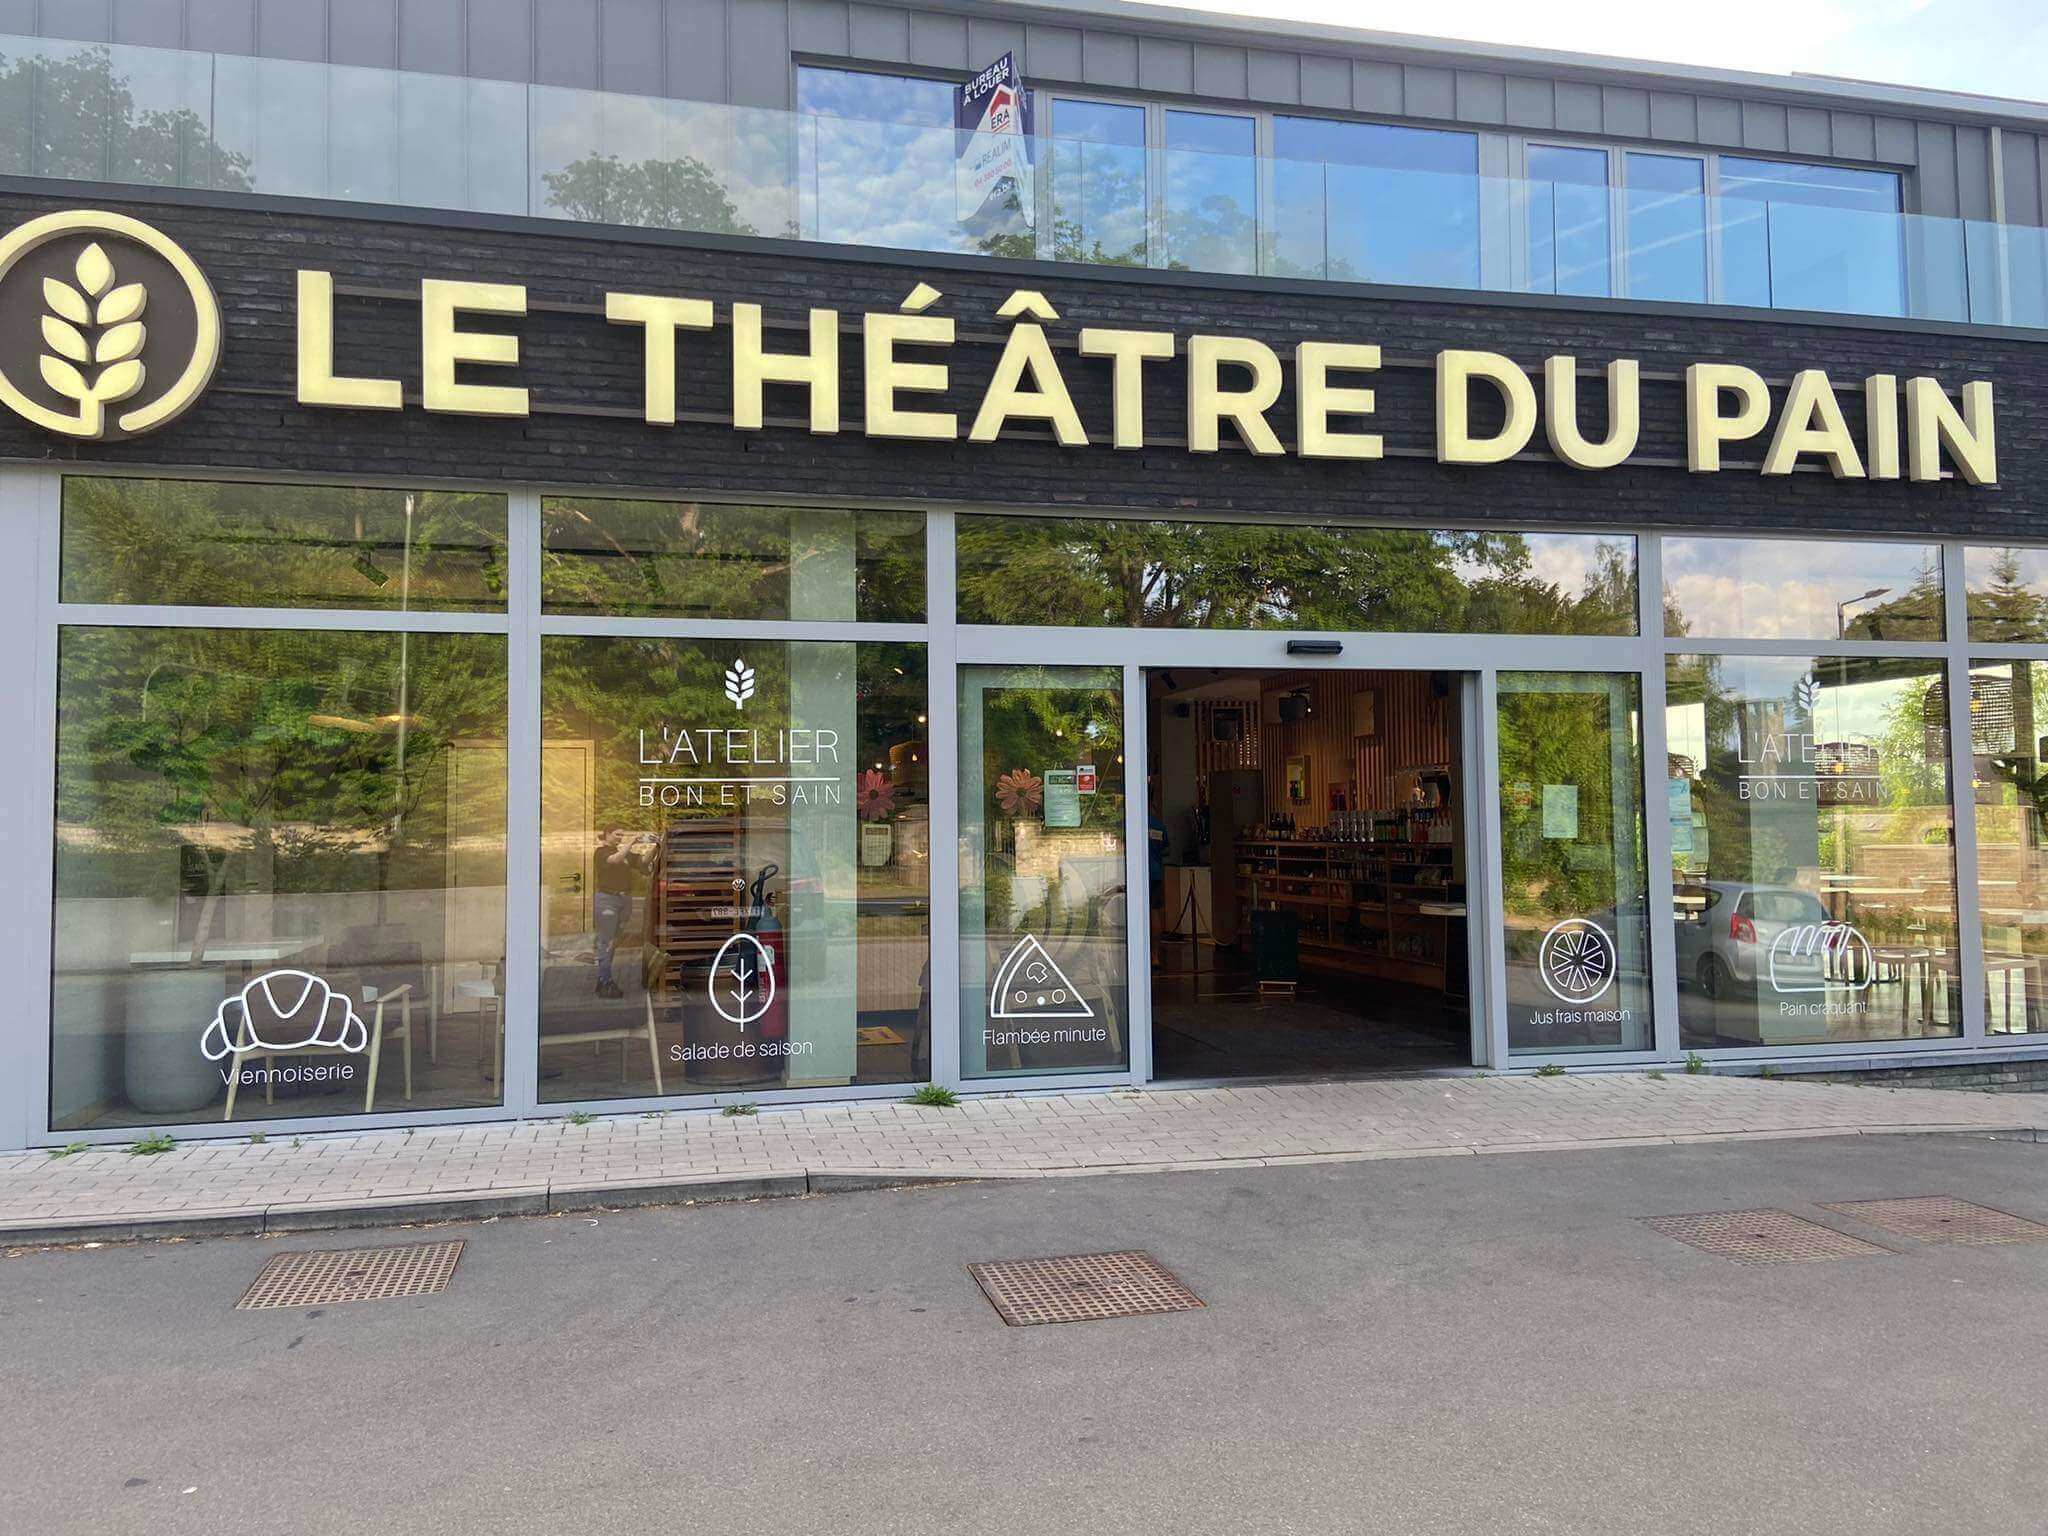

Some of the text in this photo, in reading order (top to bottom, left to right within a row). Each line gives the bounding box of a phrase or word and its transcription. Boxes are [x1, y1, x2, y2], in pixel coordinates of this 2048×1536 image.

[964, 57, 1008, 95] BUREAU
[973, 67, 1010, 99] LOUER
[990, 108, 1010, 130] ERA
[296, 269, 1998, 486] LE THÉÂTRE DU PAIN
[639, 727, 840, 764] L'ATELIER
[639, 784, 841, 806] BON ET SAIN
[1739, 780, 1888, 800] BON ET SAIN
[1529, 1008, 1631, 1025] Jus frais maison
[1780, 1001, 1867, 1016] Pain craquant
[982, 1027, 1107, 1046] Flambée minute
[670, 1040, 814, 1061] Salade de saison
[219, 1063, 354, 1086] Viennoiserie
